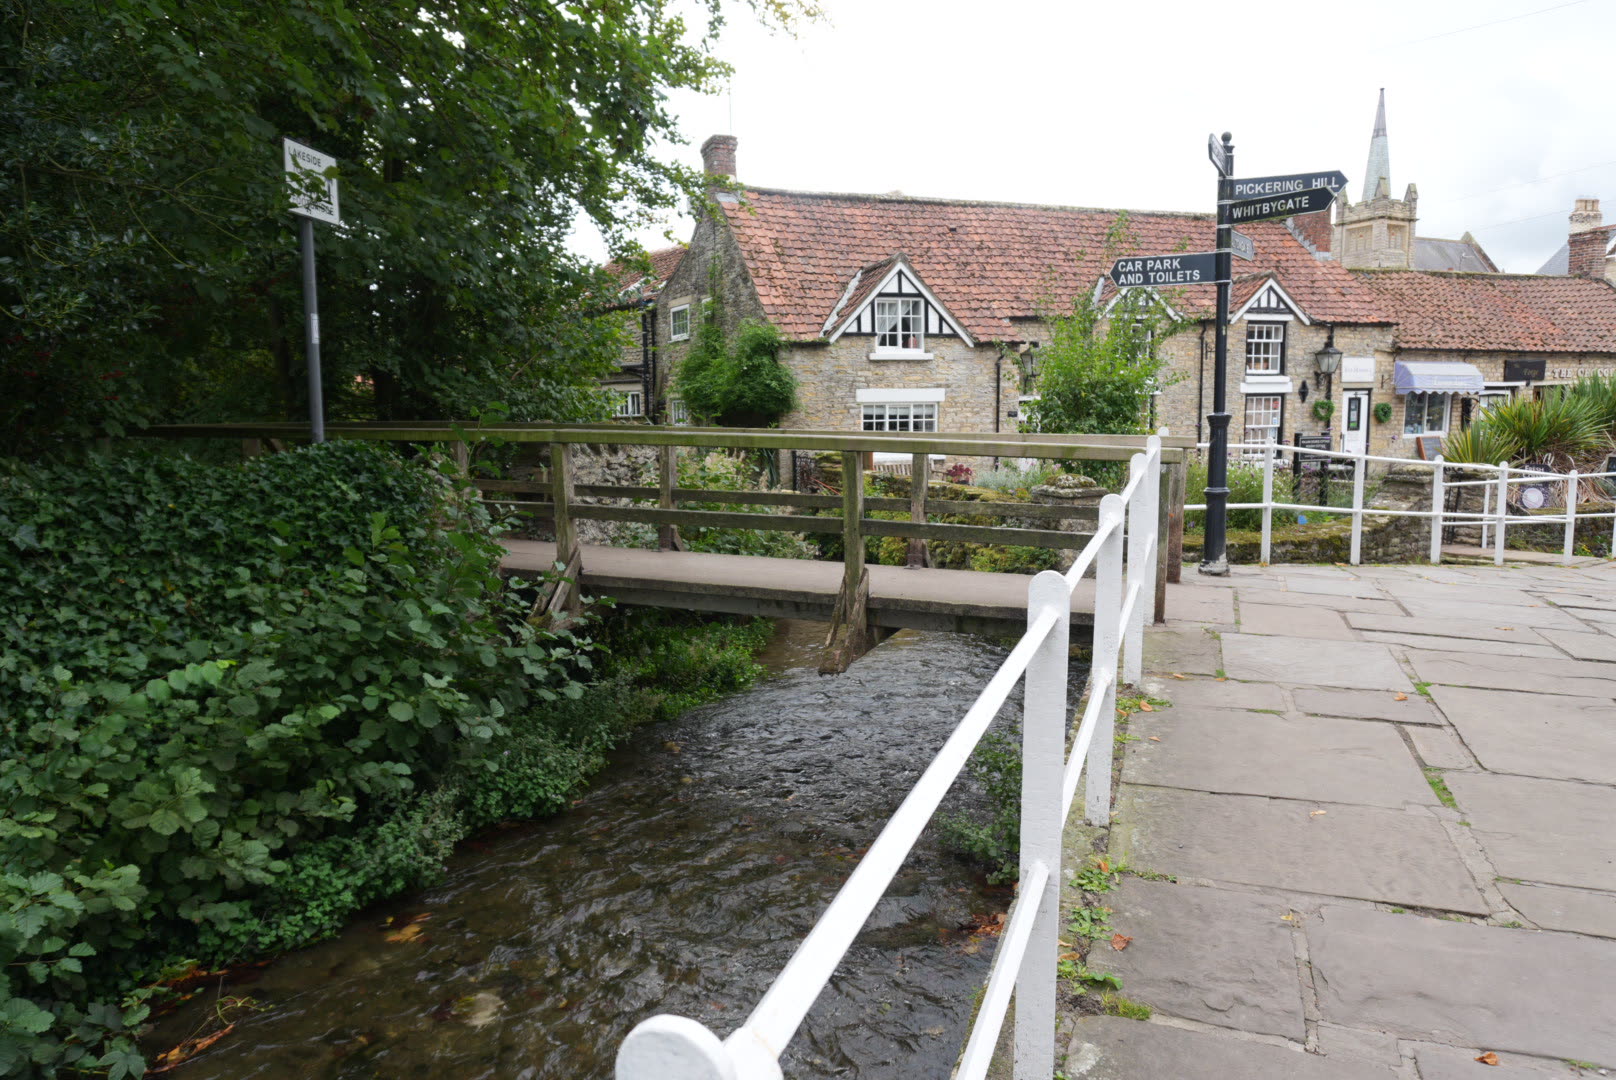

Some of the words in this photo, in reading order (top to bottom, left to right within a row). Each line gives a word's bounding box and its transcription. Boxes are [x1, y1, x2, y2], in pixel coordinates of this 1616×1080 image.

[288, 146, 321, 168] LAKESIDE
[1235, 179, 1303, 195] PICKERING
[1312, 176, 1339, 191] HILL
[1232, 196, 1309, 219] WHITBYGATE
[1118, 261, 1142, 272] CAR
[1147, 258, 1181, 271] PARK
[1118, 274, 1143, 285] AND
[1149, 270, 1200, 283] TOILETS
[1553, 368, 1572, 378] THE
